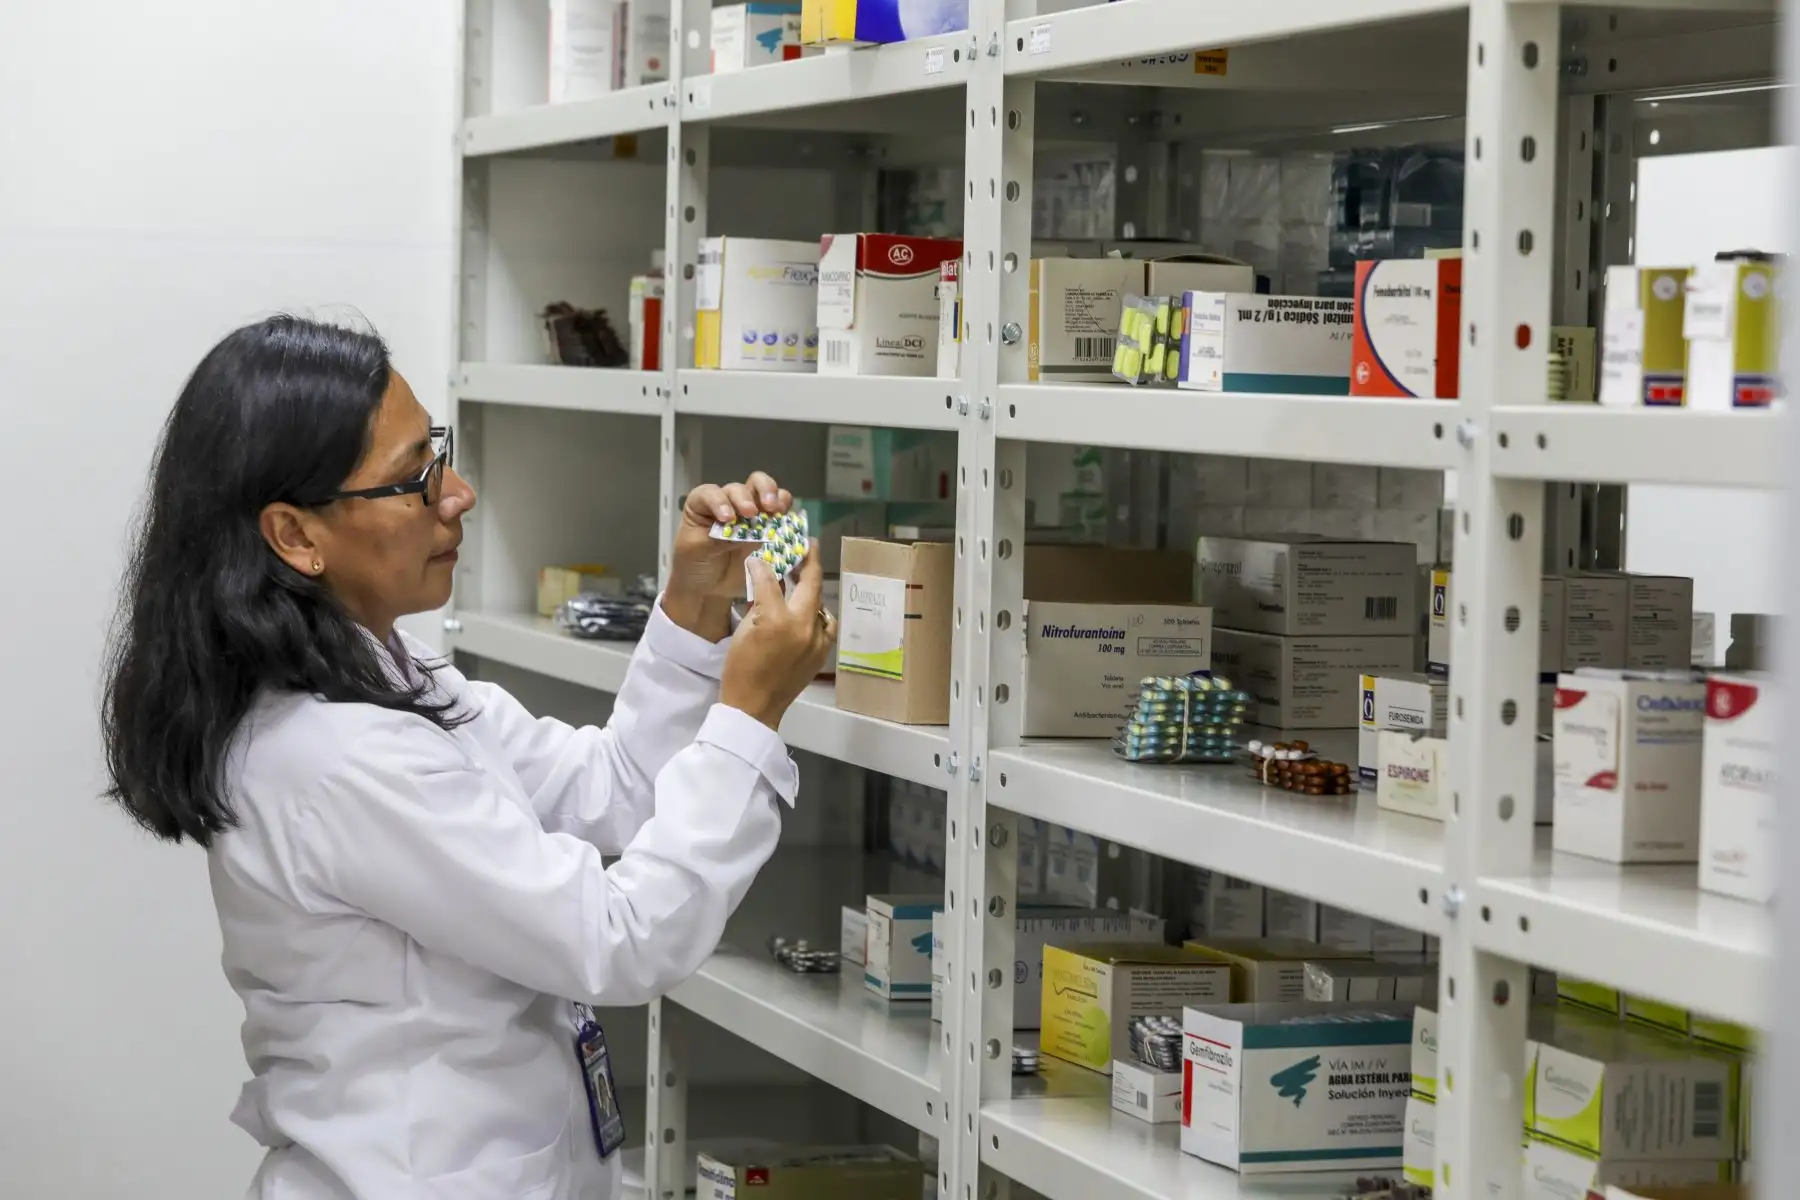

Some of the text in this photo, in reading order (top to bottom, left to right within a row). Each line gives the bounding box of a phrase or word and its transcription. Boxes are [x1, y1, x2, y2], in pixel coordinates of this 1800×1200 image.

[1314, 301, 1335, 311] para
[1283, 311, 1319, 325] Sódico
[1041, 624, 1126, 640] Nitrofurantoína
[1097, 643, 1125, 655] 100 mg
[1388, 710, 1424, 725] FUROSEMIDA
[1351, 1060, 1365, 1070] IM
[1328, 1075, 1354, 1086] AGUA
[1328, 1088, 1376, 1100] Solución
